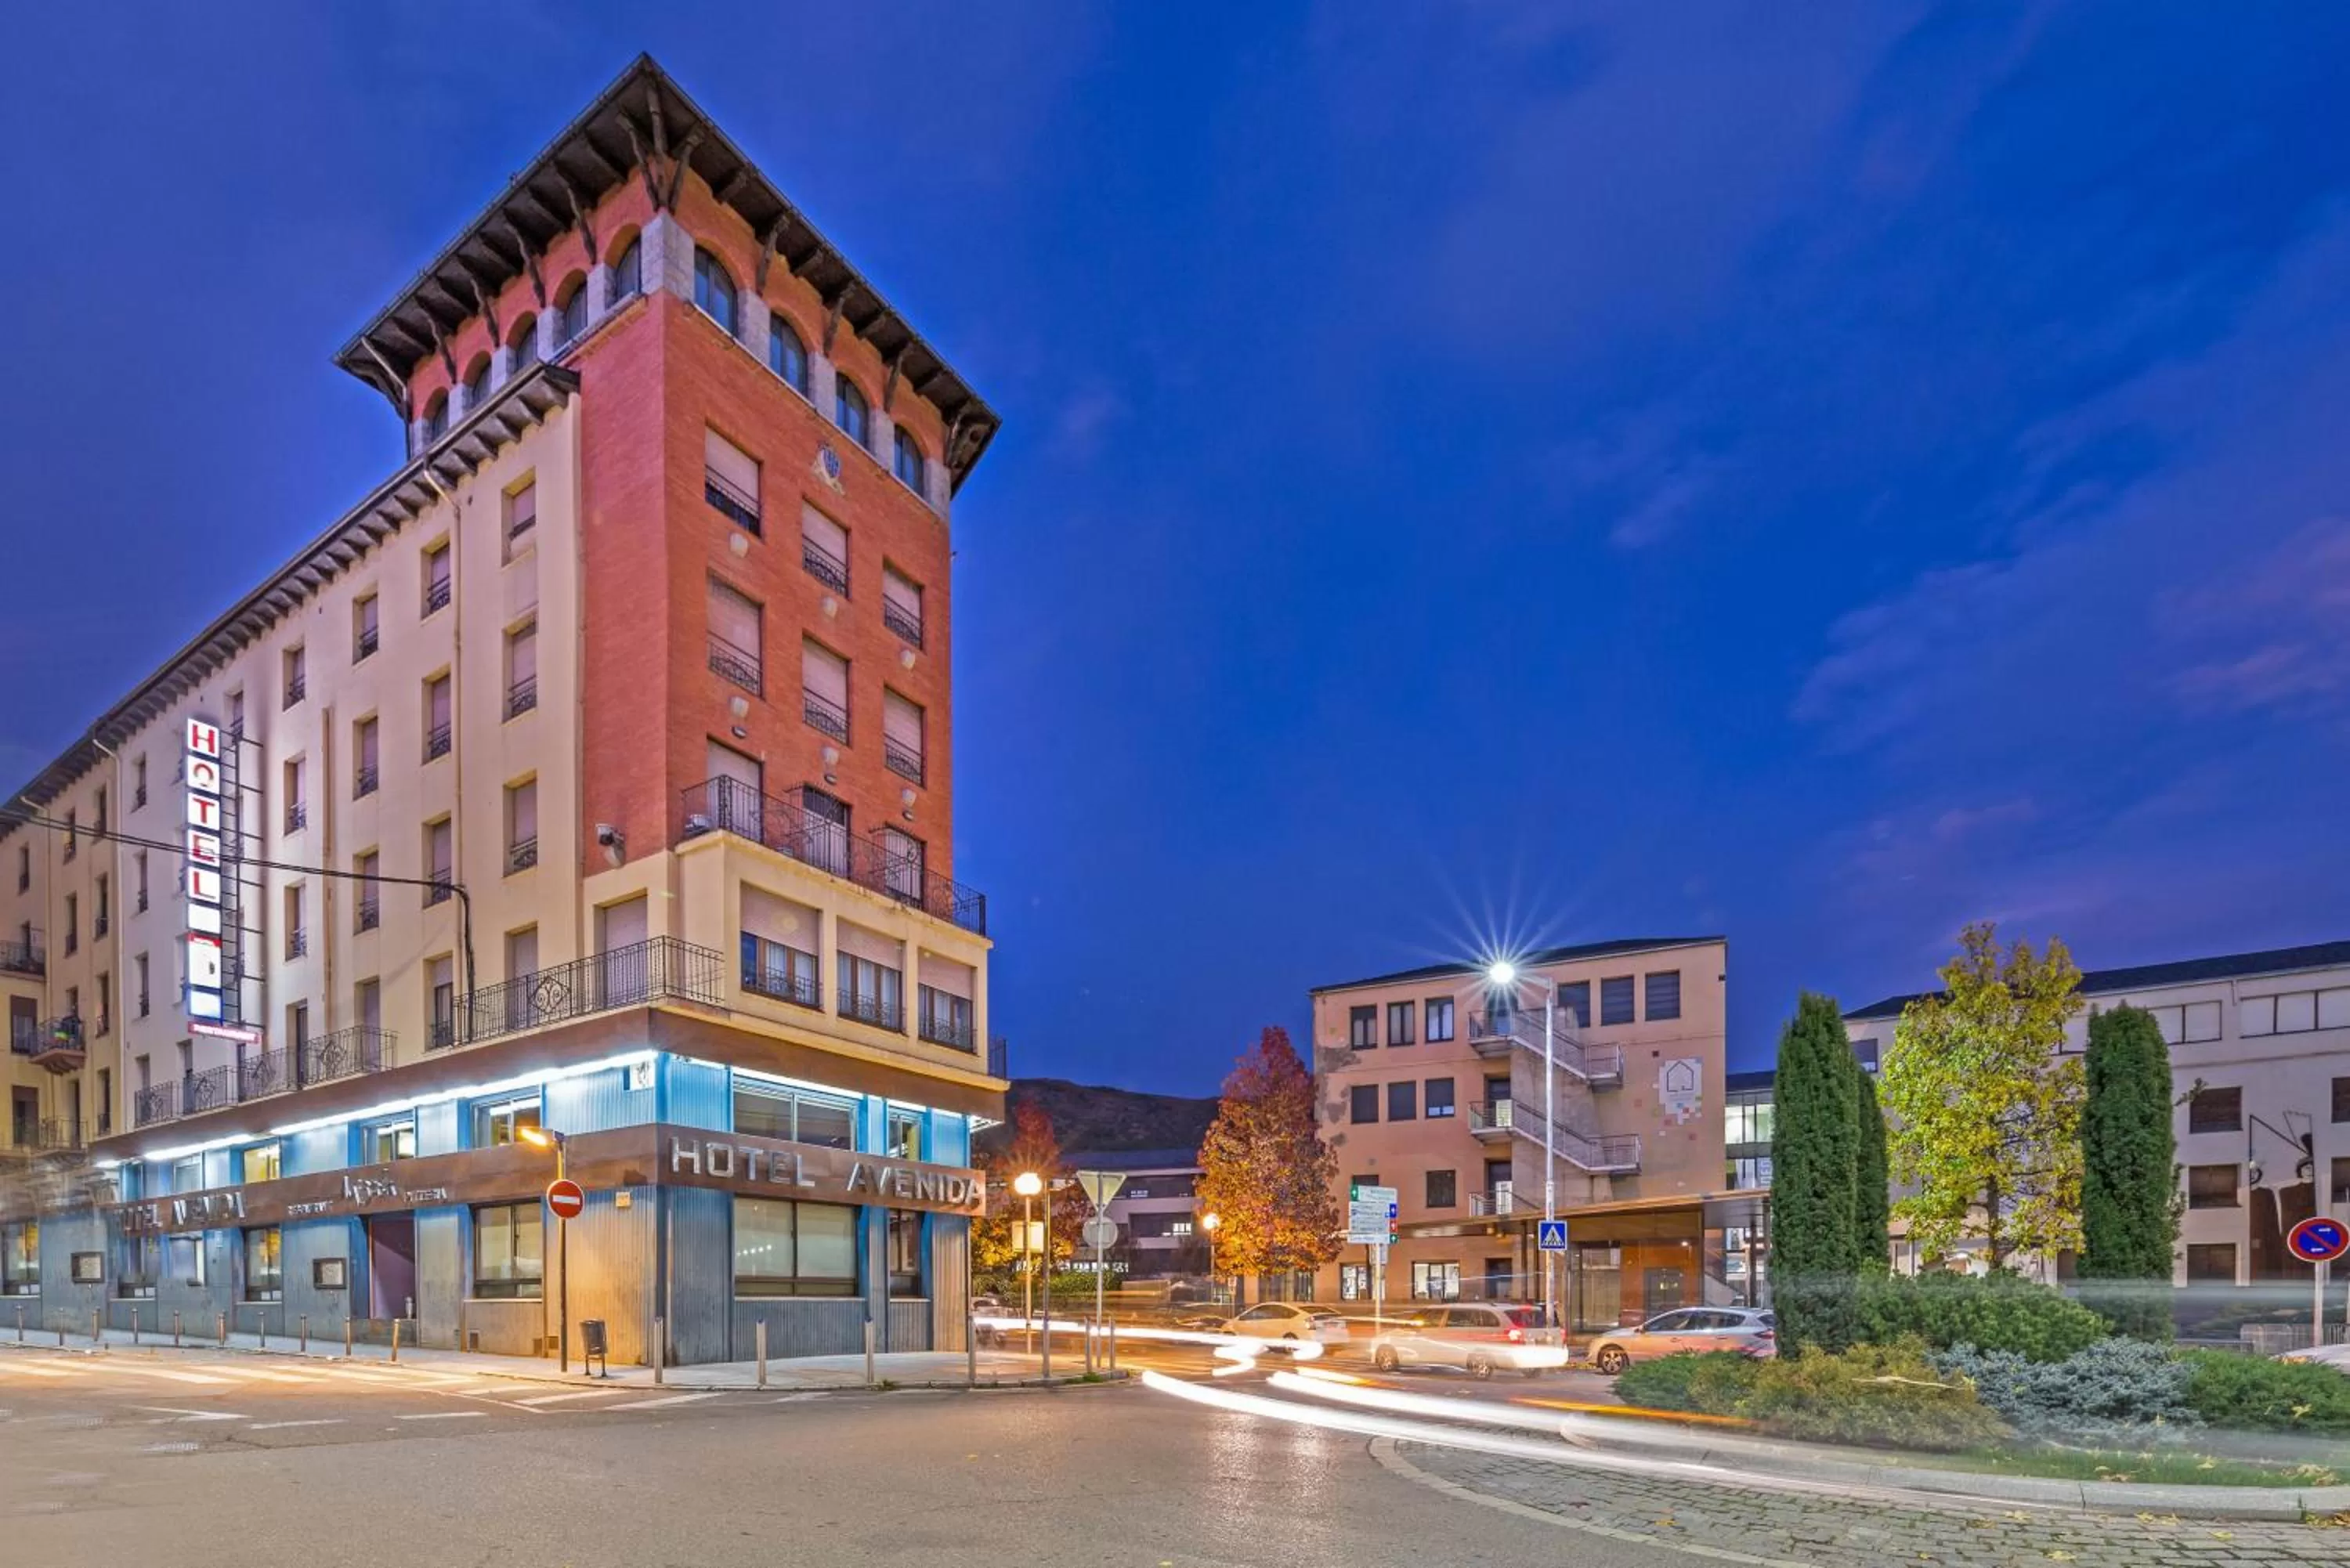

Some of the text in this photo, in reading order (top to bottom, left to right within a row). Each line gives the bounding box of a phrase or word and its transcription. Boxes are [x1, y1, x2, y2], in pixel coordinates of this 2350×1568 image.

[192, 722, 216, 901] HOTEL
[669, 1136, 983, 1206] HOTEL AVENIDA
